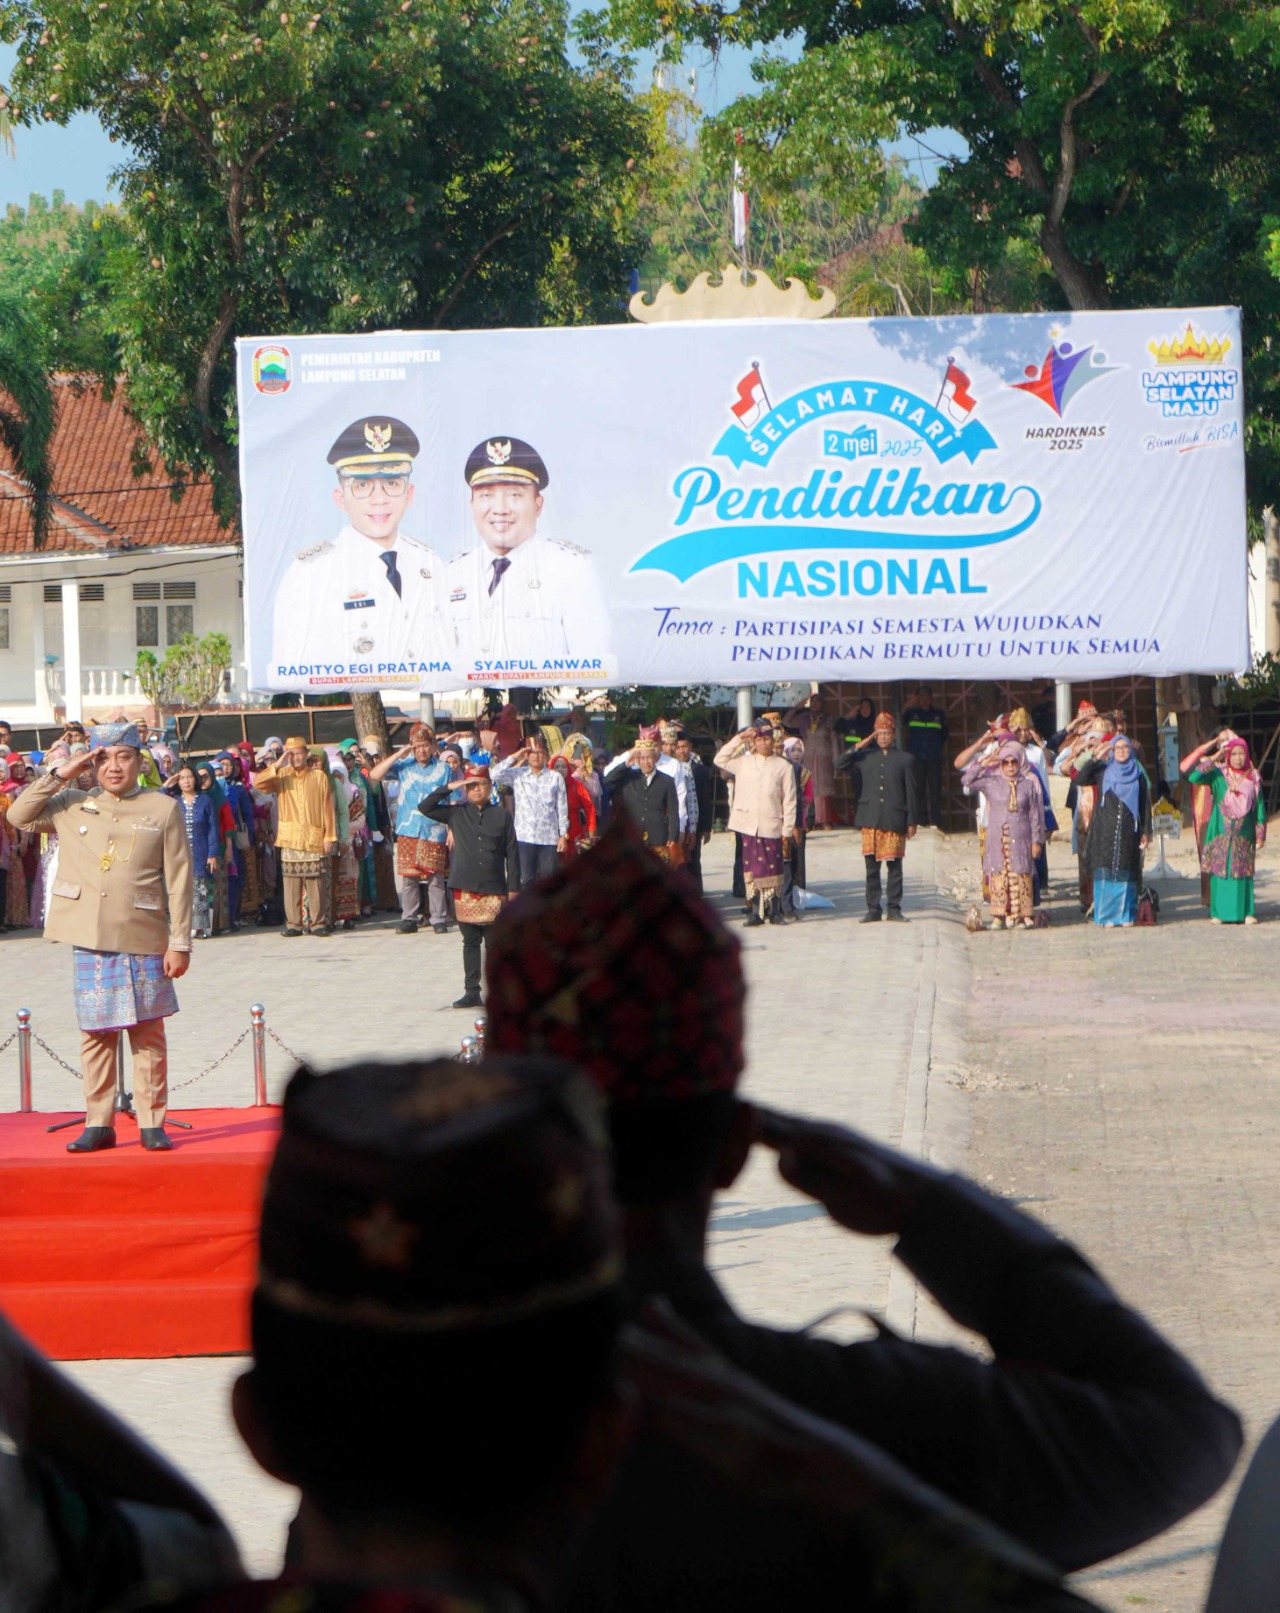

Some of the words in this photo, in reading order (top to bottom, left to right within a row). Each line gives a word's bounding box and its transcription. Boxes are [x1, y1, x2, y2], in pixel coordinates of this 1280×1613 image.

[301, 352, 375, 367] PEMERINTAH
[376, 349, 441, 364] KABUPATEN
[301, 369, 356, 383] LAMPUNG
[358, 367, 406, 382] SELATAN
[1142, 369, 1238, 388] LAMPUNG
[1146, 384, 1234, 402] SELATAN
[1163, 400, 1219, 417] MAJU
[750, 386, 879, 457] SELAMAT
[890, 394, 954, 449] HARI
[1026, 425, 1107, 439] HARDIKNAS
[1146, 431, 1200, 451] Bismillah
[1207, 420, 1239, 441] BISA
[827, 433, 839, 453] 2
[843, 432, 876, 456] mei
[880, 438, 926, 458] 2025
[1048, 438, 1084, 451] 2025
[673, 466, 1012, 526] Pendidikan
[736, 557, 988, 598] NASIONAL
[653, 606, 714, 637] Tema
[278, 664, 345, 676] RADITYO
[349, 663, 373, 675] EGI
[378, 661, 452, 674] PRATAMA
[474, 660, 538, 671] SYAIFUL
[542, 658, 602, 670] ANWAR
[342, 676, 380, 684] LAMPUNG
